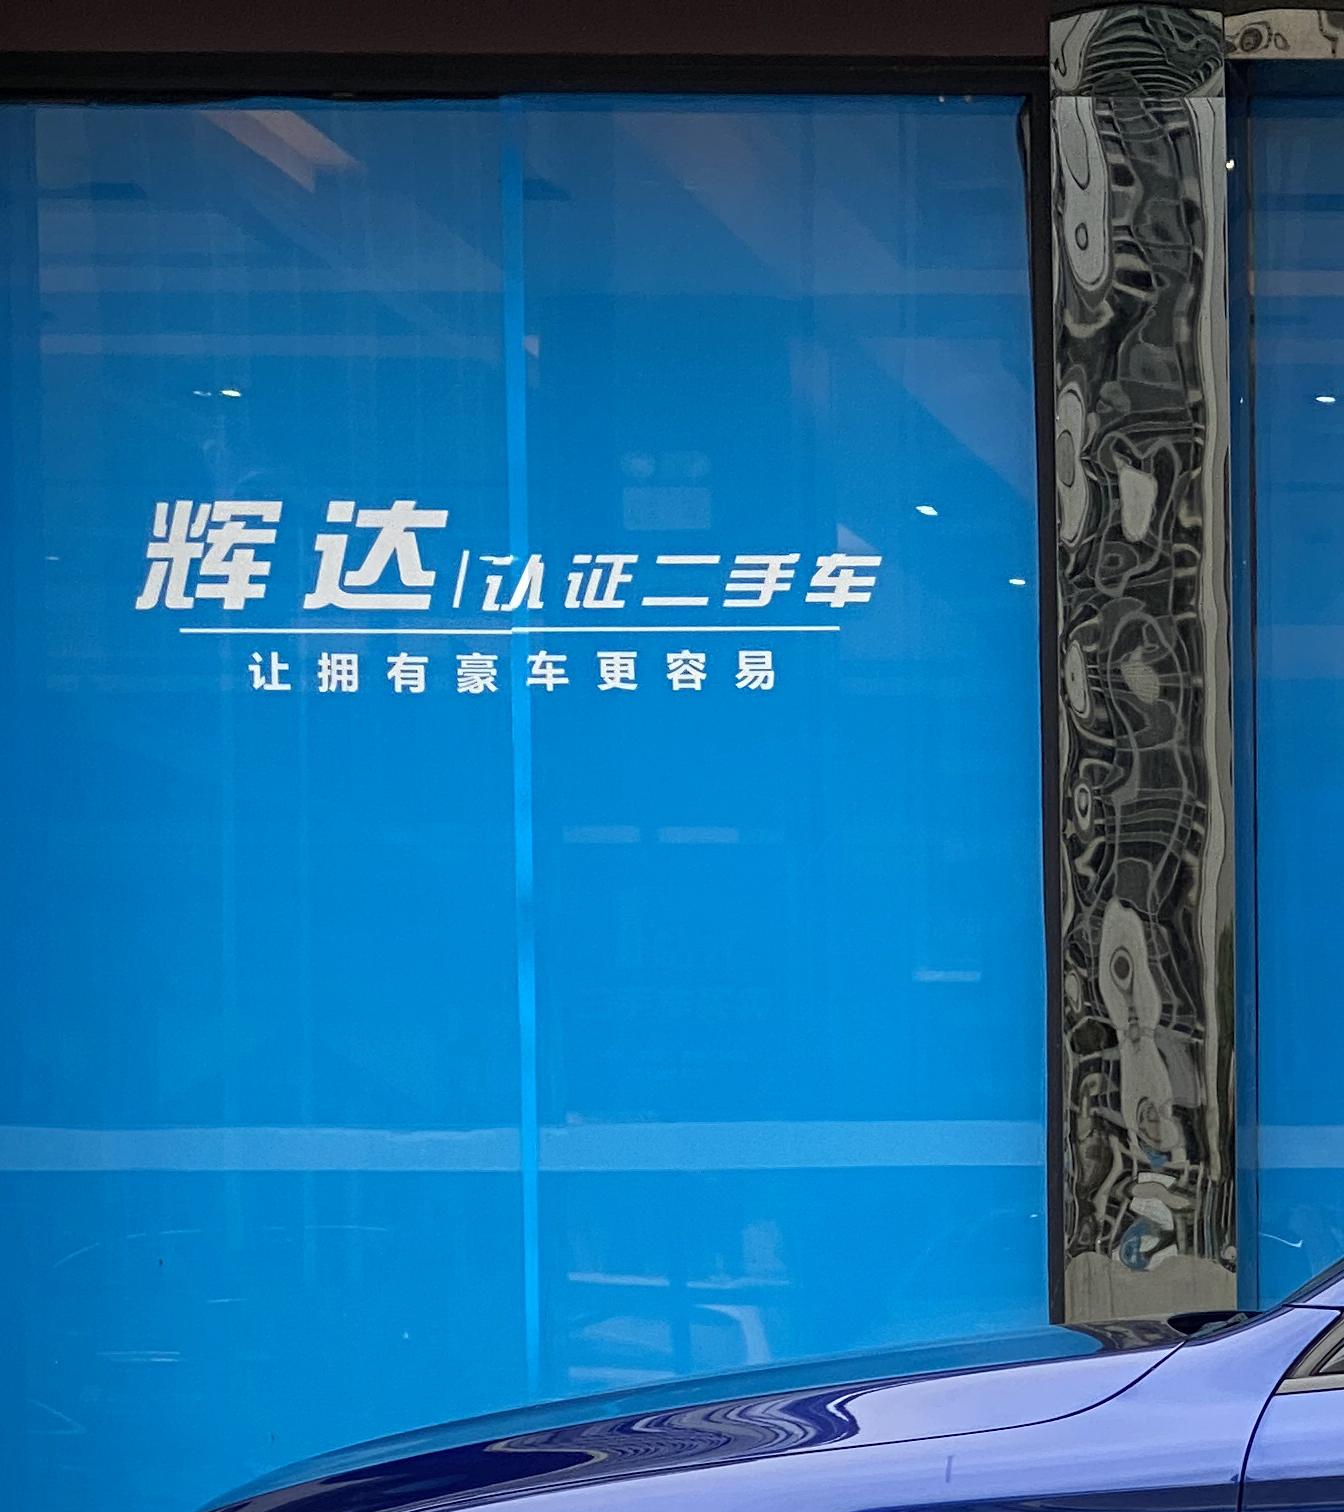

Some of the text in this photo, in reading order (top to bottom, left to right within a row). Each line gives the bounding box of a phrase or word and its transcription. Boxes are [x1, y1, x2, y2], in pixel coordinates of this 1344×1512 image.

[248, 649, 776, 694] 让拥有豪车更容易
